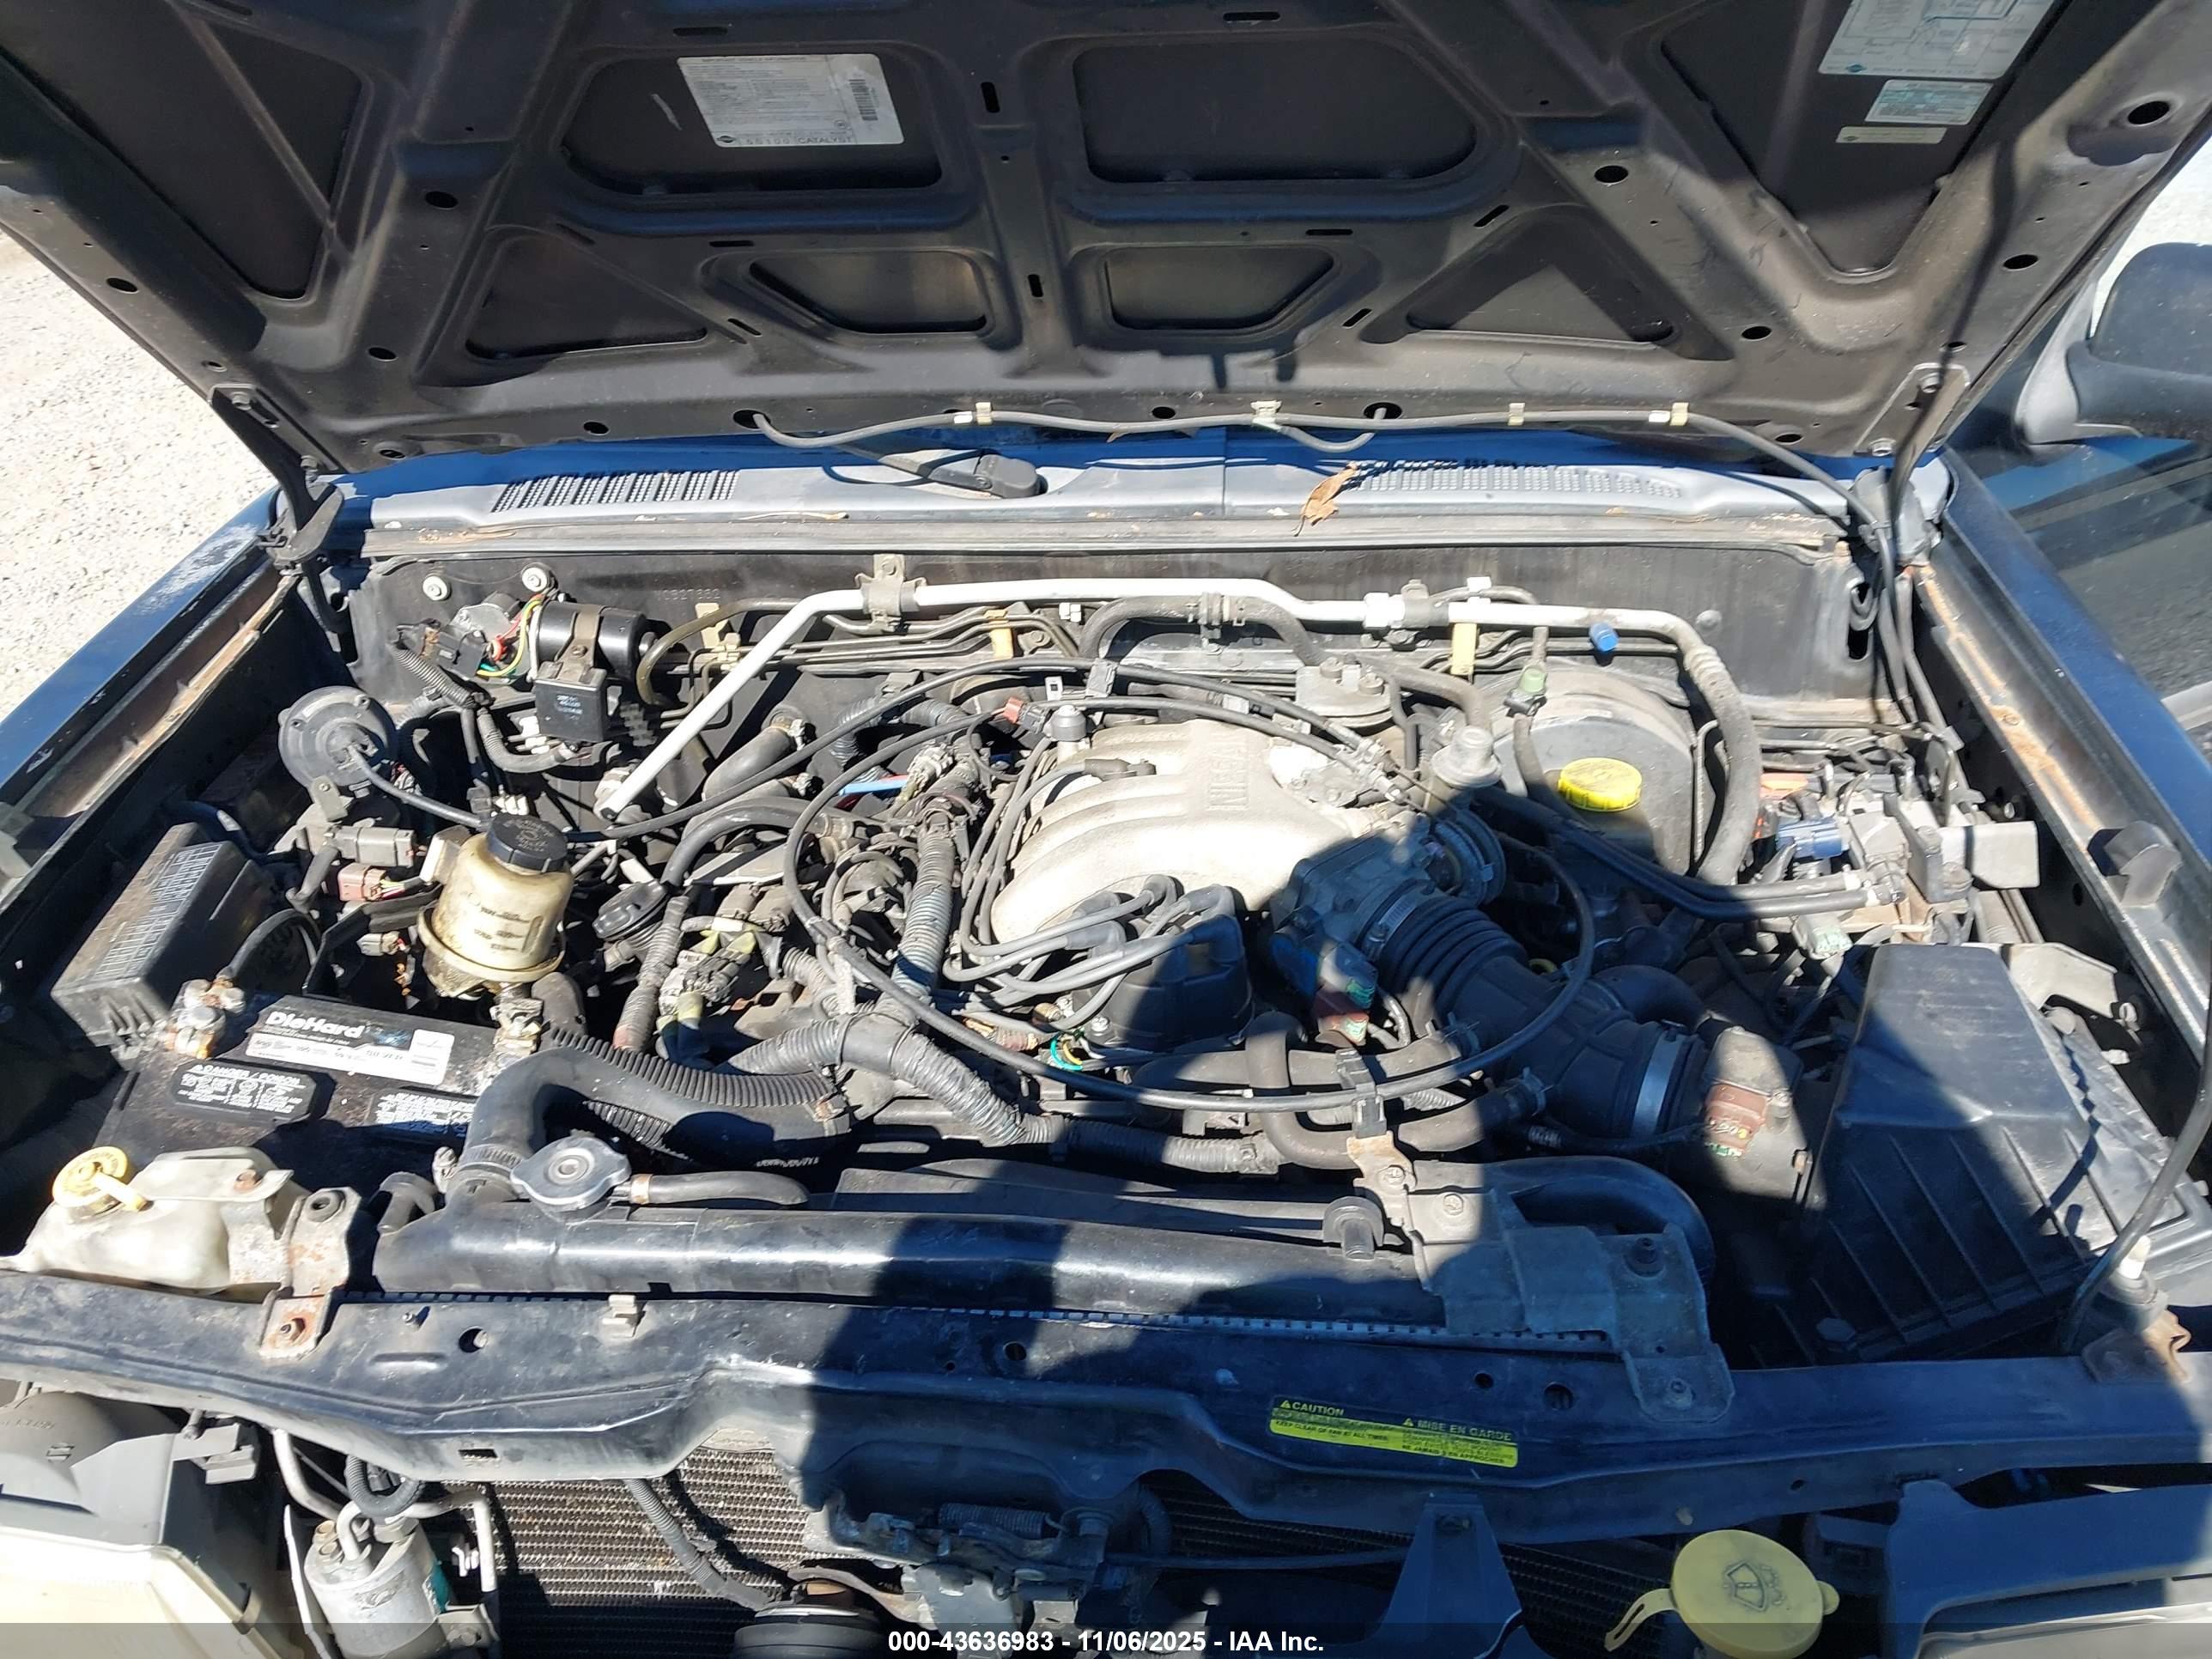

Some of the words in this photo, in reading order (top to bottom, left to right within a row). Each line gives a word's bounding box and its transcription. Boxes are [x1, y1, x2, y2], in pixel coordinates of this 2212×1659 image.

[796, 136, 852, 144] CATALYST
[264, 1011, 364, 1039] DieHard
[258, 1073, 301, 1085] POISON
[1291, 1401, 1345, 1416] CAUTION
[1295, 1423, 1316, 1431] CLEAR
[1417, 1419, 1448, 1431] MISE
[1449, 1425, 1467, 1434] EN
[1469, 1427, 1512, 1441] GARDE
